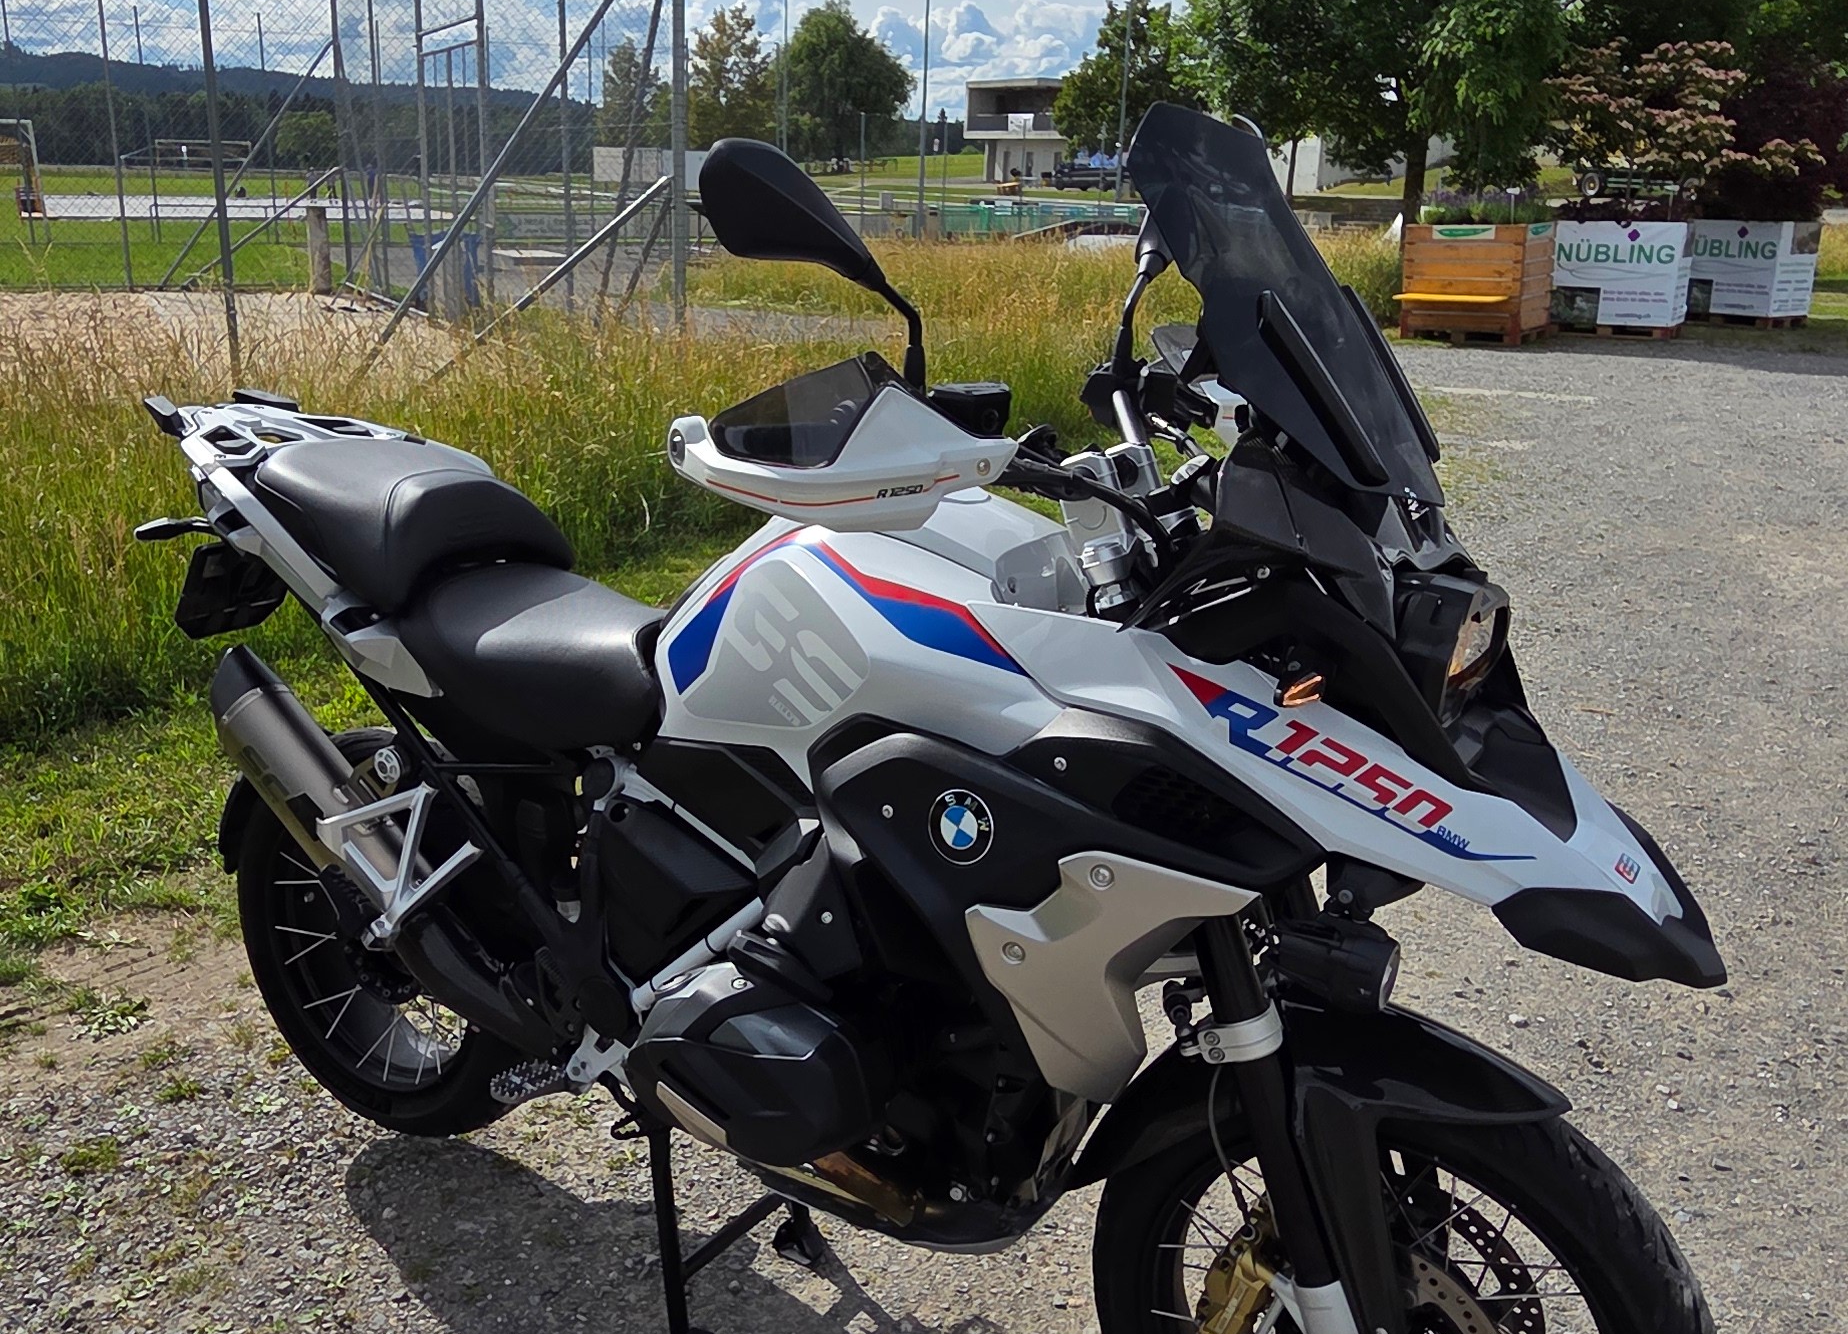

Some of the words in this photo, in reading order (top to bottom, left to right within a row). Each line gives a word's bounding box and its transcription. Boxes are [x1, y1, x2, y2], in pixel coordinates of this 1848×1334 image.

[1556, 238, 1676, 264] NÜBLING
[1693, 234, 1778, 260] ÜBLING
[1436, 825, 1471, 851] BMW
